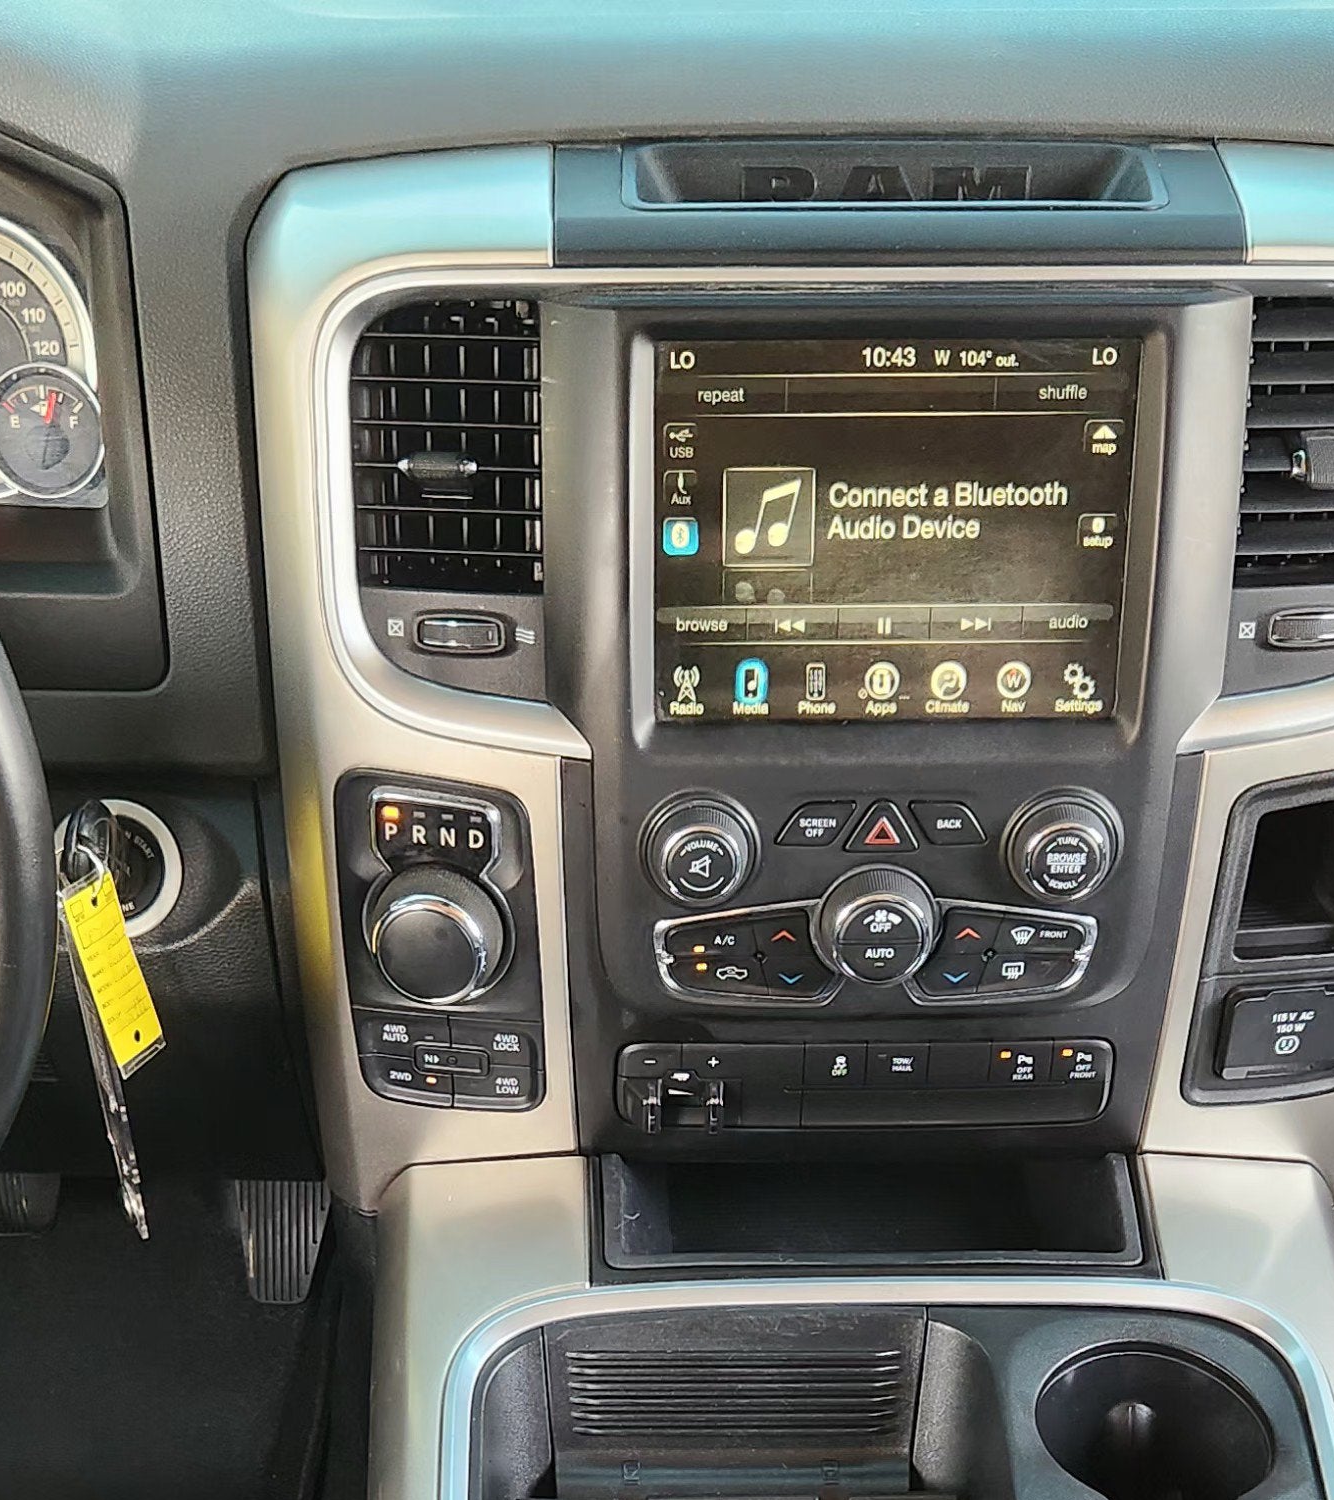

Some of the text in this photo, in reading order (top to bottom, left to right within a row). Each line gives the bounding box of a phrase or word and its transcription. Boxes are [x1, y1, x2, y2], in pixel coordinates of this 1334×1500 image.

[741, 164, 1033, 201] RAM
[21, 307, 46, 324] 110
[32, 341, 60, 356] 120
[670, 351, 695, 370] LO
[861, 347, 917, 368] 10:43
[934, 349, 951, 366] W
[996, 354, 1019, 368] out.
[1092, 348, 1118, 366] LO
[698, 384, 1088, 406] repeat shuffle
[10, 416, 21, 429] E
[69, 415, 79, 429] F
[669, 446, 694, 458] USB
[671, 493, 692, 505] Aux
[829, 481, 1068, 508] Connect a Bluetooth
[827, 514, 981, 540] Audio Device
[676, 614, 1089, 633] browse audio
[669, 698, 1104, 717] Radio Media Phone Apps Climate Nav Settings
[799, 818, 837, 828] SCREEN
[936, 819, 962, 829] BACK
[384, 825, 484, 849] P R N D
[805, 828, 825, 838] OFF
[684, 840, 720, 853] VOLUME
[1056, 836, 1081, 847] TUNE
[1046, 852, 1087, 862] BROWSE
[1050, 864, 1083, 874] ENTER
[869, 922, 893, 934] OFF
[714, 935, 736, 946] A/C
[1039, 930, 1069, 940] FRONT
[864, 948, 895, 960] AUTO
[382, 1024, 407, 1033] 4WD
[1294, 1022, 1307, 1032] W
[382, 1033, 409, 1043] AUTO
[493, 1033, 519, 1043] 4WD
[493, 1042, 520, 1052] LOCK
[389, 1070, 412, 1081] 2WD
[1012, 1073, 1034, 1081] REAR
[1069, 1071, 1096, 1079] FRONT
[495, 1077, 519, 1086] 4WD
[496, 1085, 519, 1095] LOW
